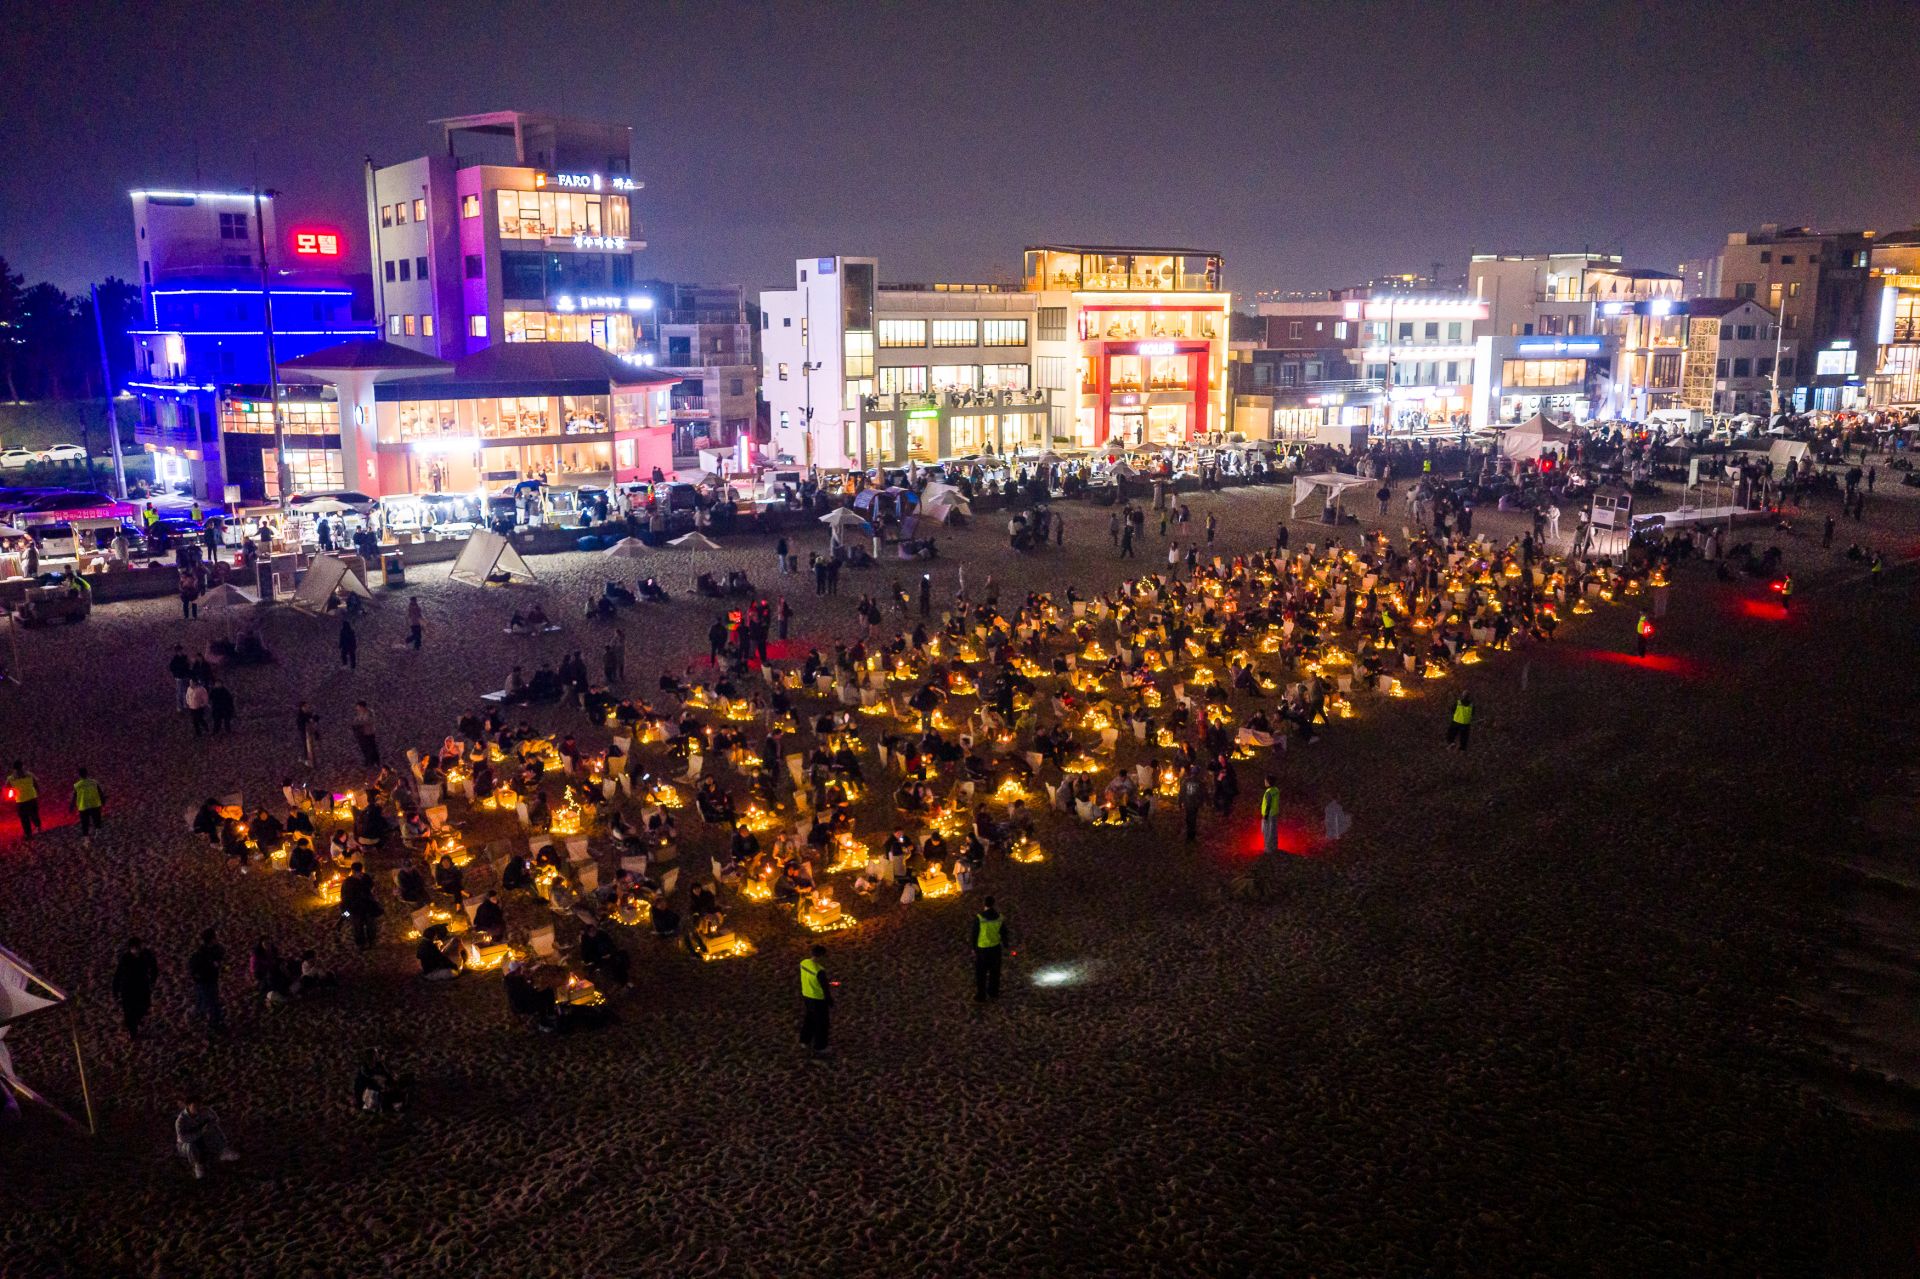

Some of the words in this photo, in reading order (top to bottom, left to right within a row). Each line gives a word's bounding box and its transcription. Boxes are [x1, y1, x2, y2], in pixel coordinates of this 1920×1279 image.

[558, 174, 591, 187] FARO
[297, 234, 338, 255] 모텔
[1529, 395, 1571, 409] CAFE25
